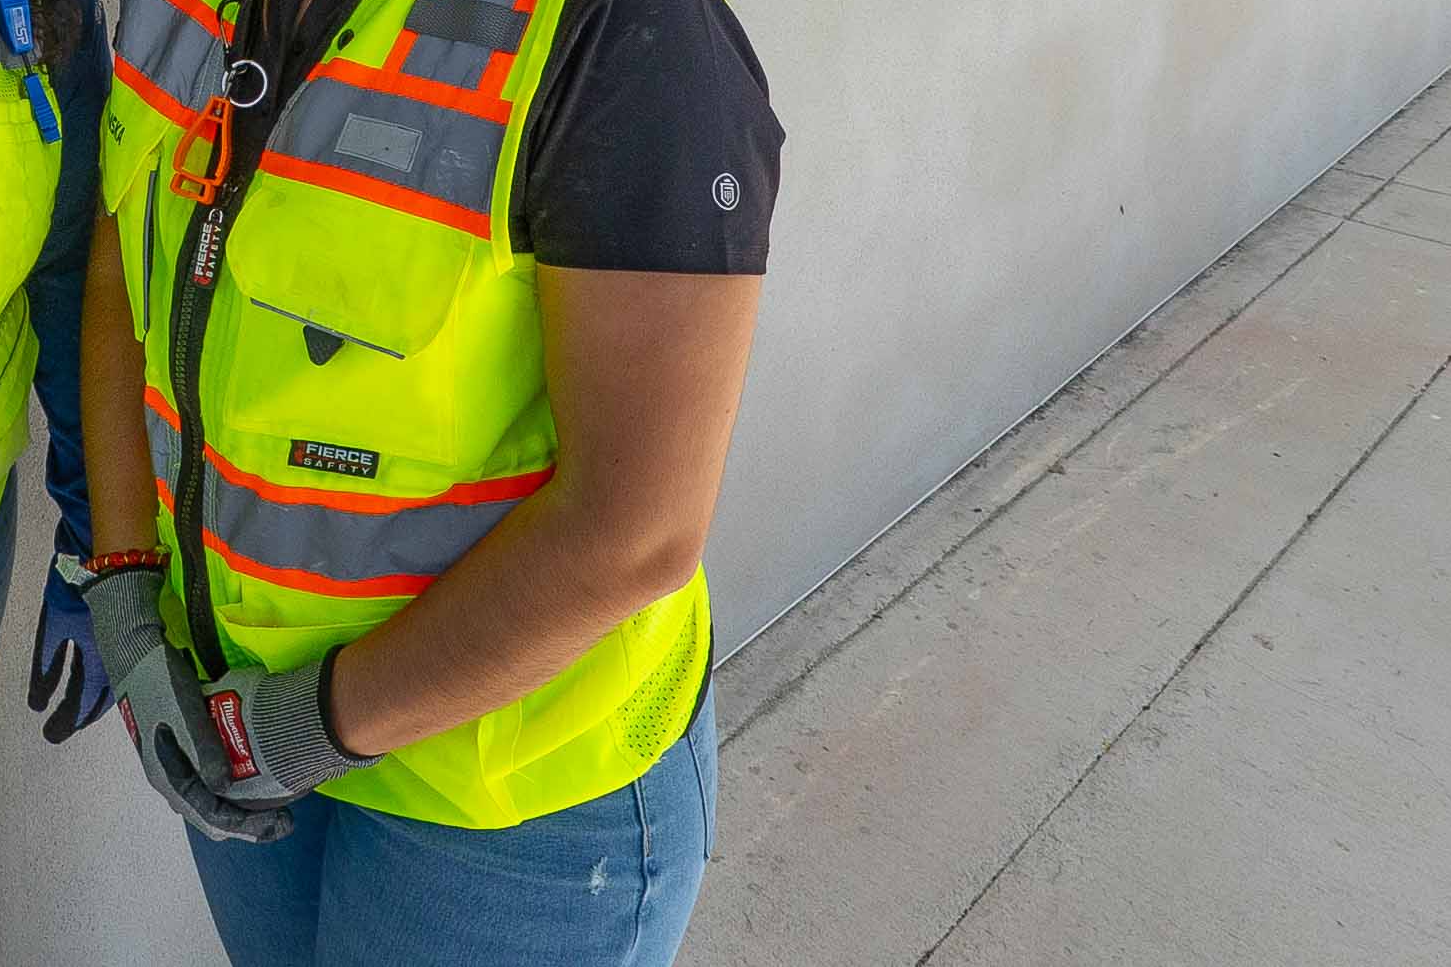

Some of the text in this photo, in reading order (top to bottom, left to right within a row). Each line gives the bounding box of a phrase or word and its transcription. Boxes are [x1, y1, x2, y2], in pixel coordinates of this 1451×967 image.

[194, 222, 213, 276] FIERCE
[205, 224, 222, 278] SAFETY
[303, 457, 371, 476] SAFETY
[305, 442, 374, 466] FIERCE
[221, 698, 247, 756] Milwaukee
